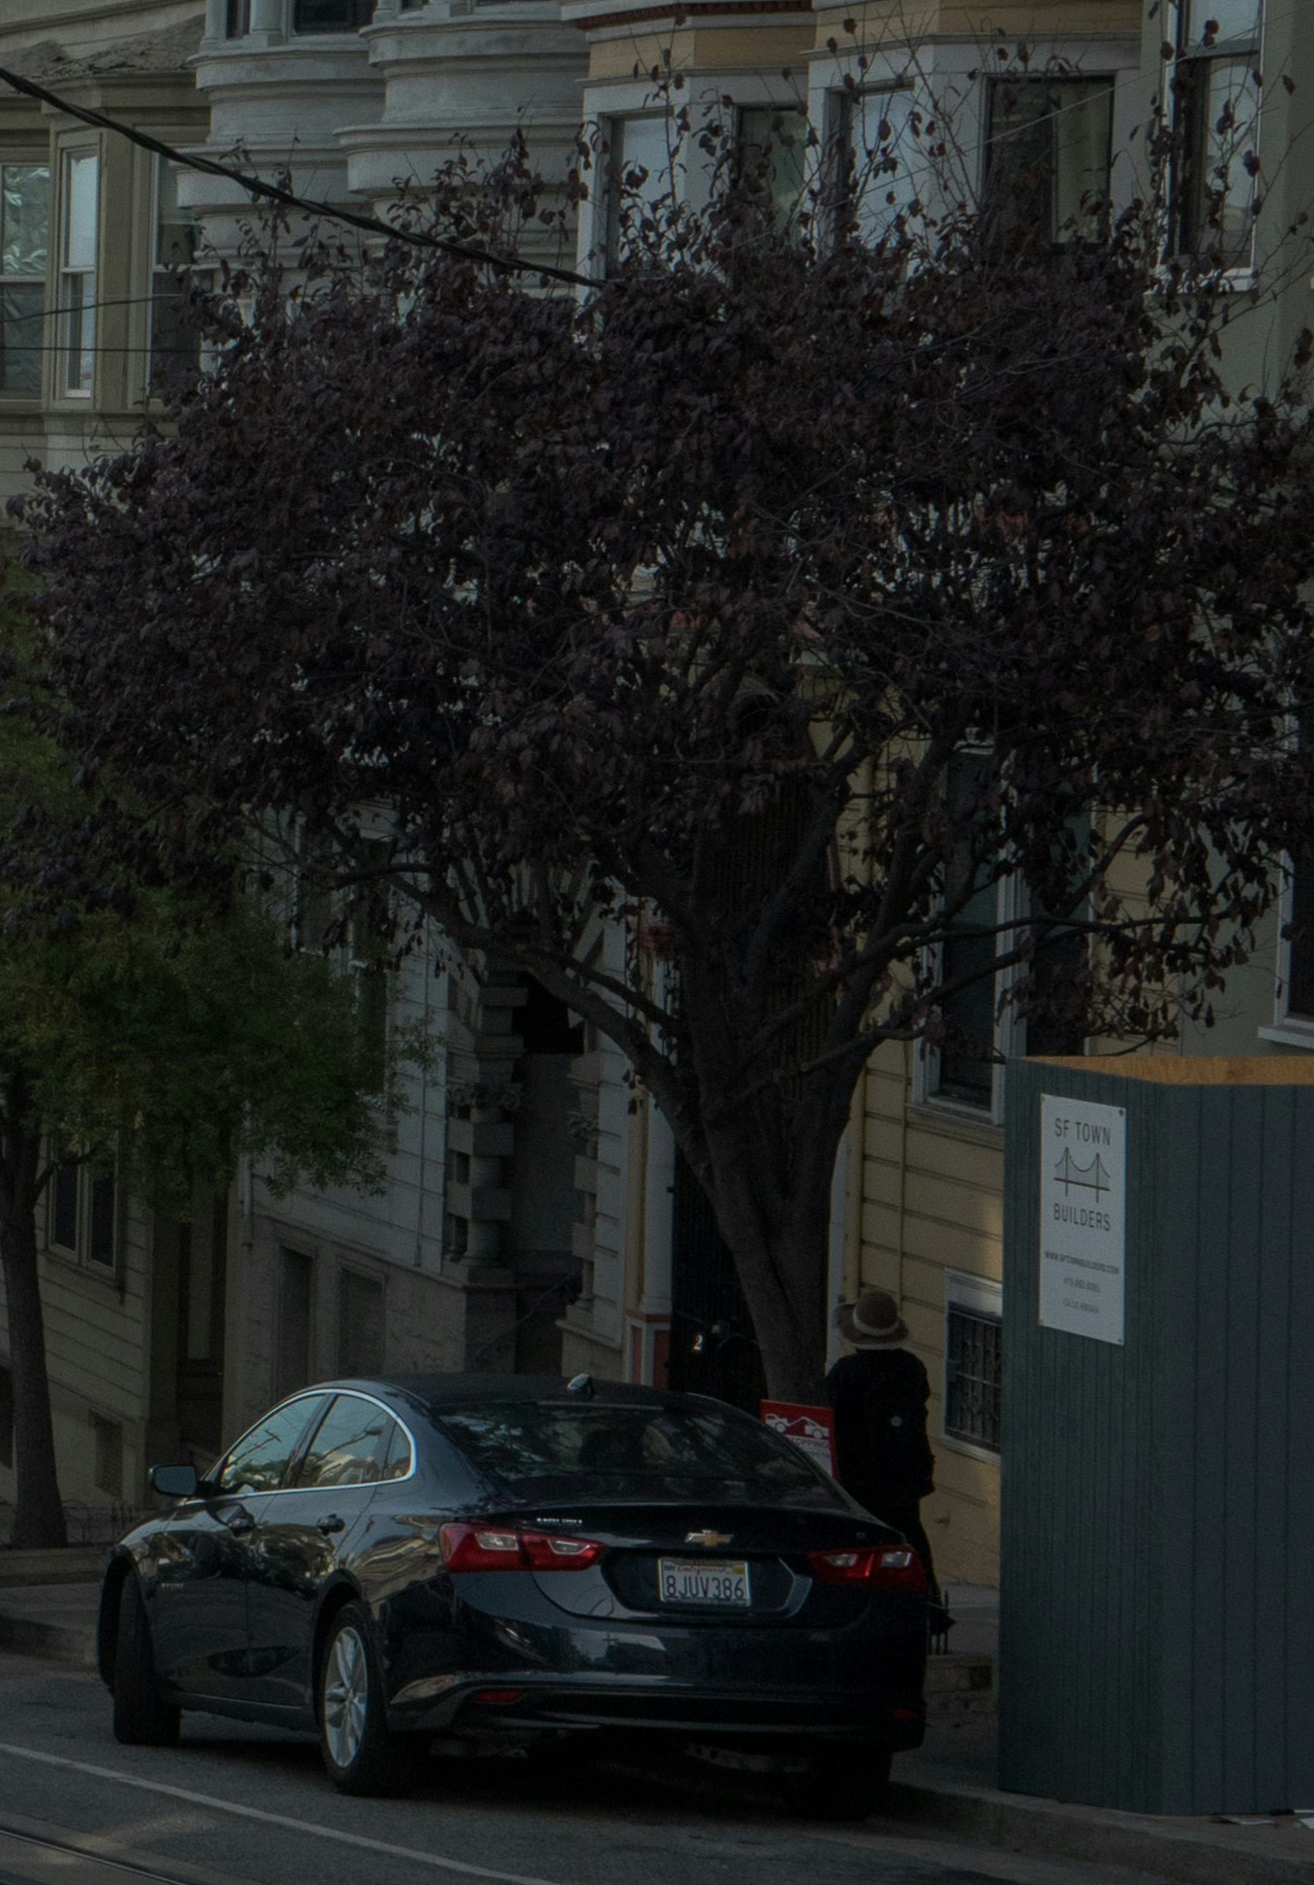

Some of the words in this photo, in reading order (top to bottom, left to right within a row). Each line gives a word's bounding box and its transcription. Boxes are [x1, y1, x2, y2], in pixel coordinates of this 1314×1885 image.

[1054, 1118, 1070, 1138] SF
[1075, 1121, 1111, 1146] TOWN
[1054, 1202, 1111, 1232] BUILDERS
[665, 1575, 744, 1600] 8JUV386
